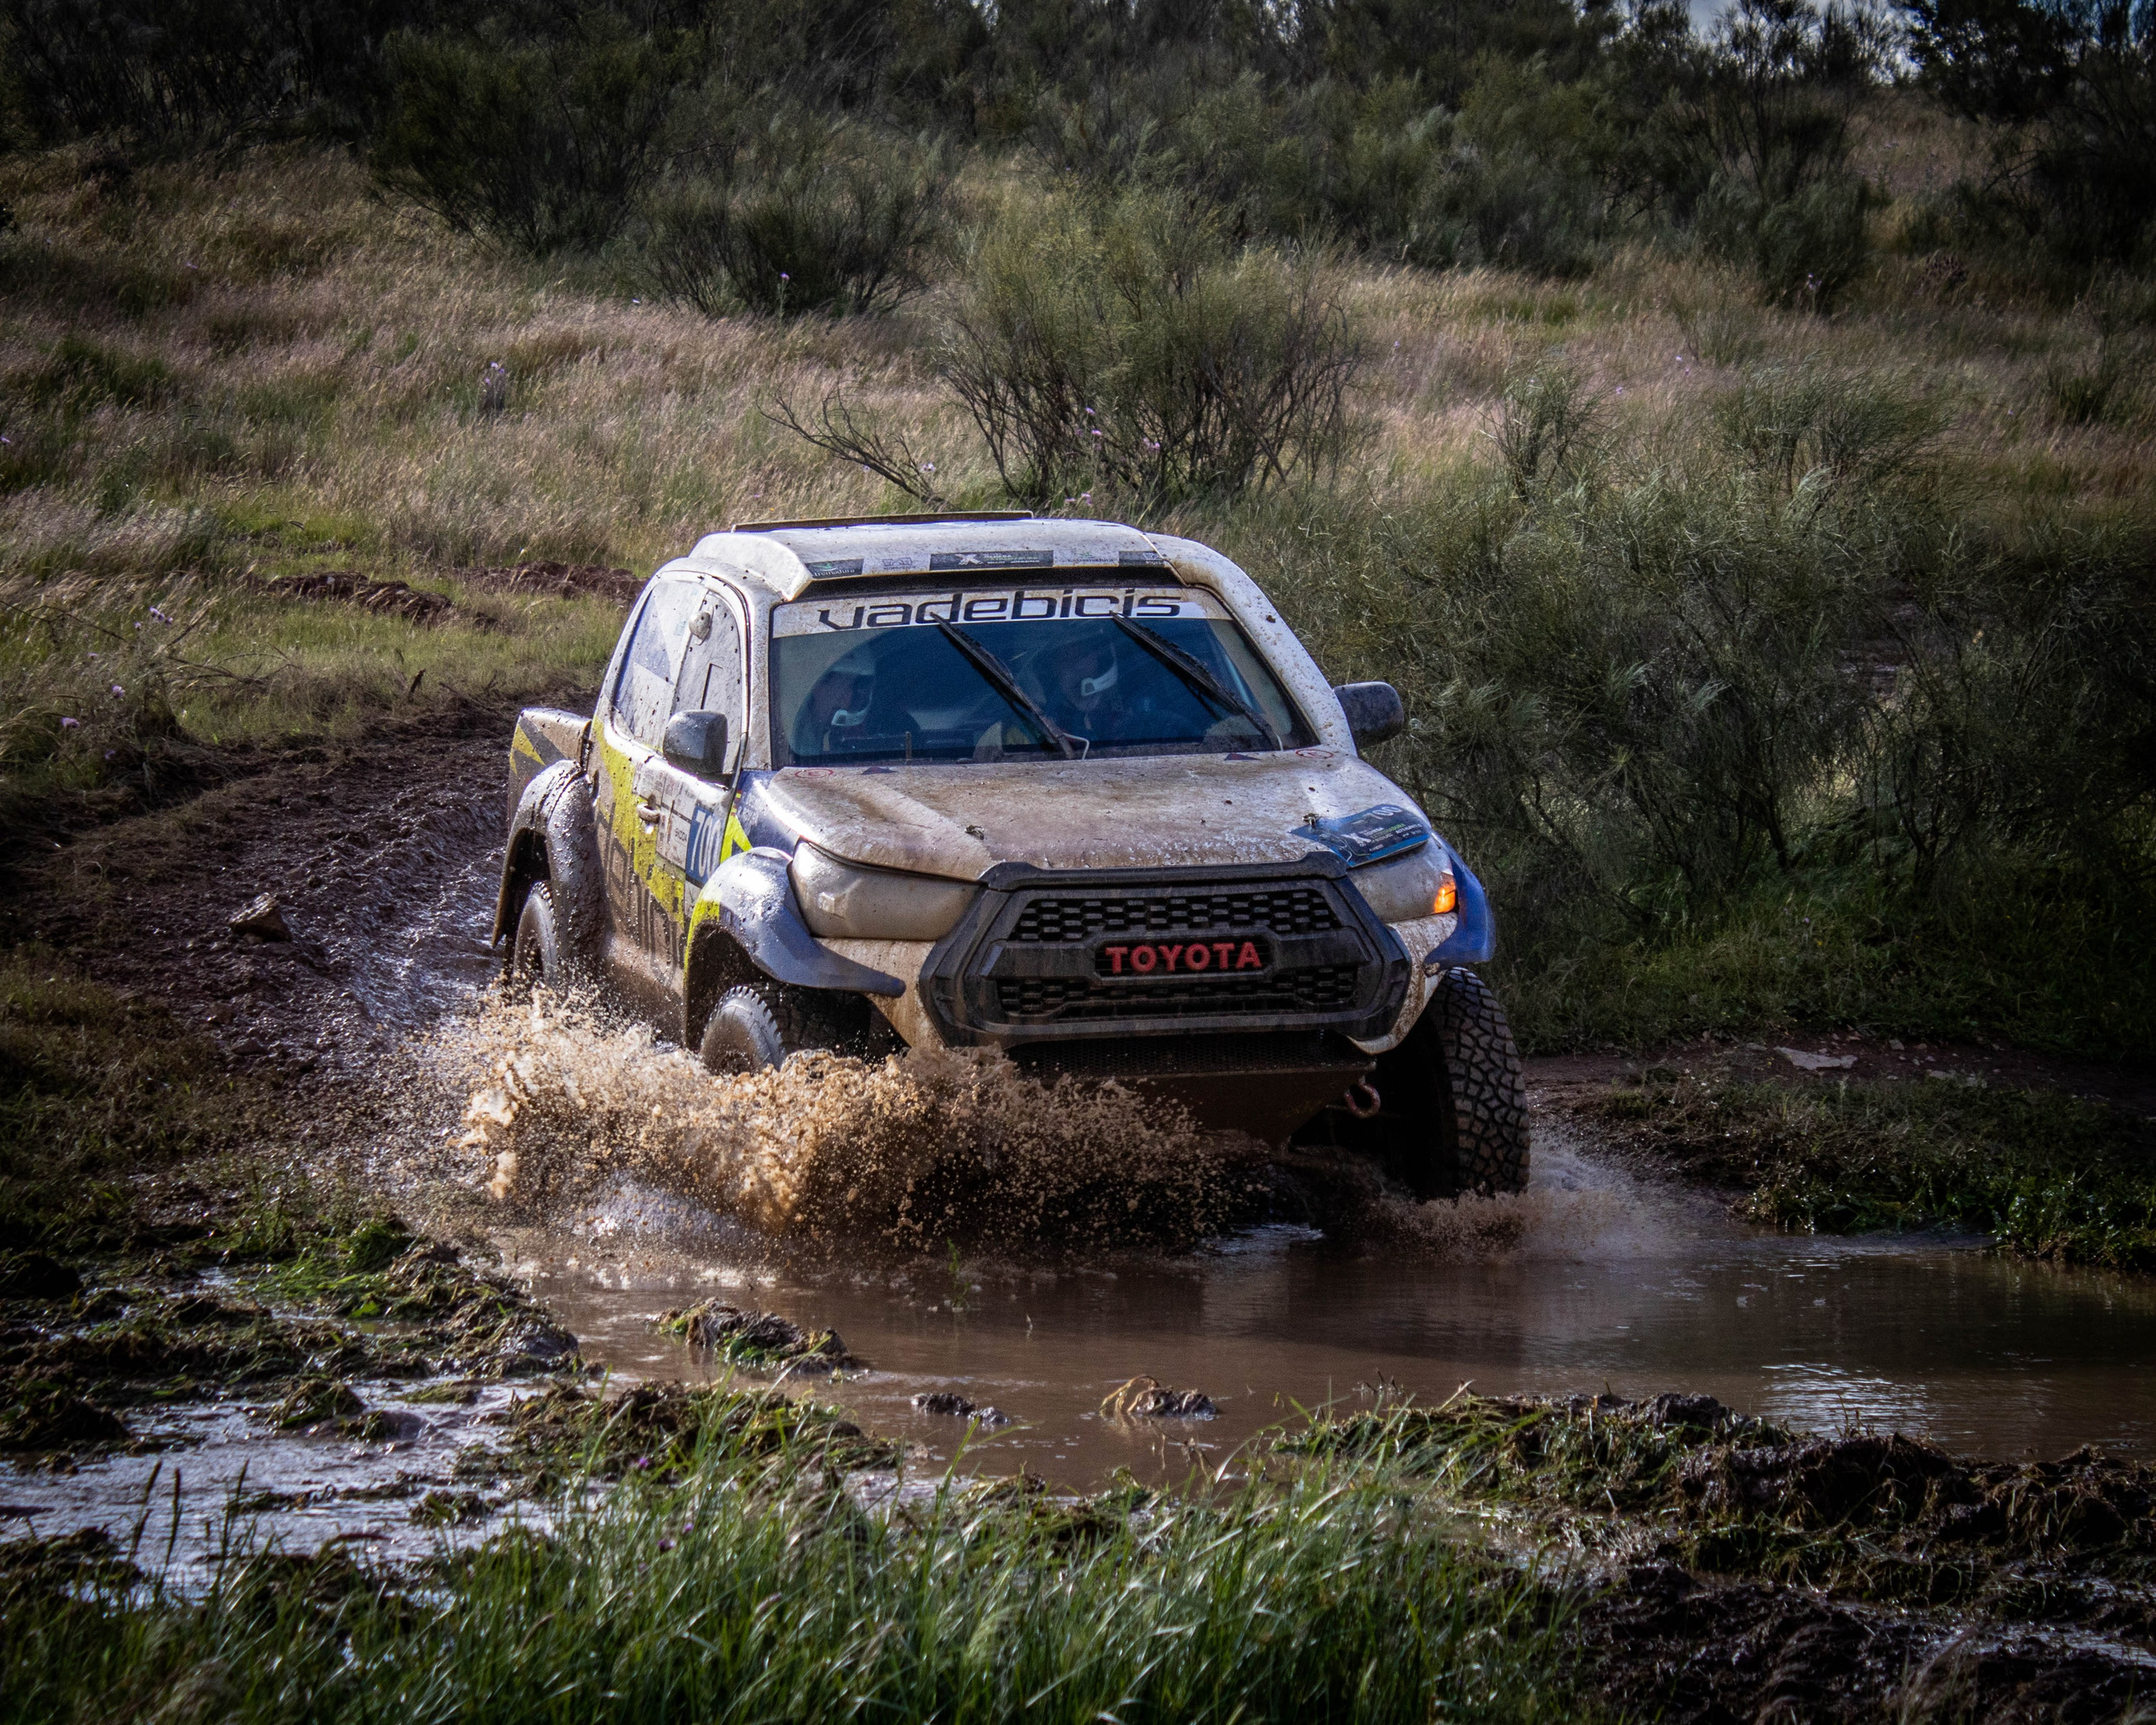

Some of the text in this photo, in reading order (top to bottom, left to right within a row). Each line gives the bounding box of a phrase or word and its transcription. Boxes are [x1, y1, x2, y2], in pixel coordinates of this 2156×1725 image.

[817, 589, 1183, 631] vadebicis
[1362, 805, 1403, 820] 700
[691, 809, 723, 879] 700
[1106, 942, 1262, 974] TOYOTA
